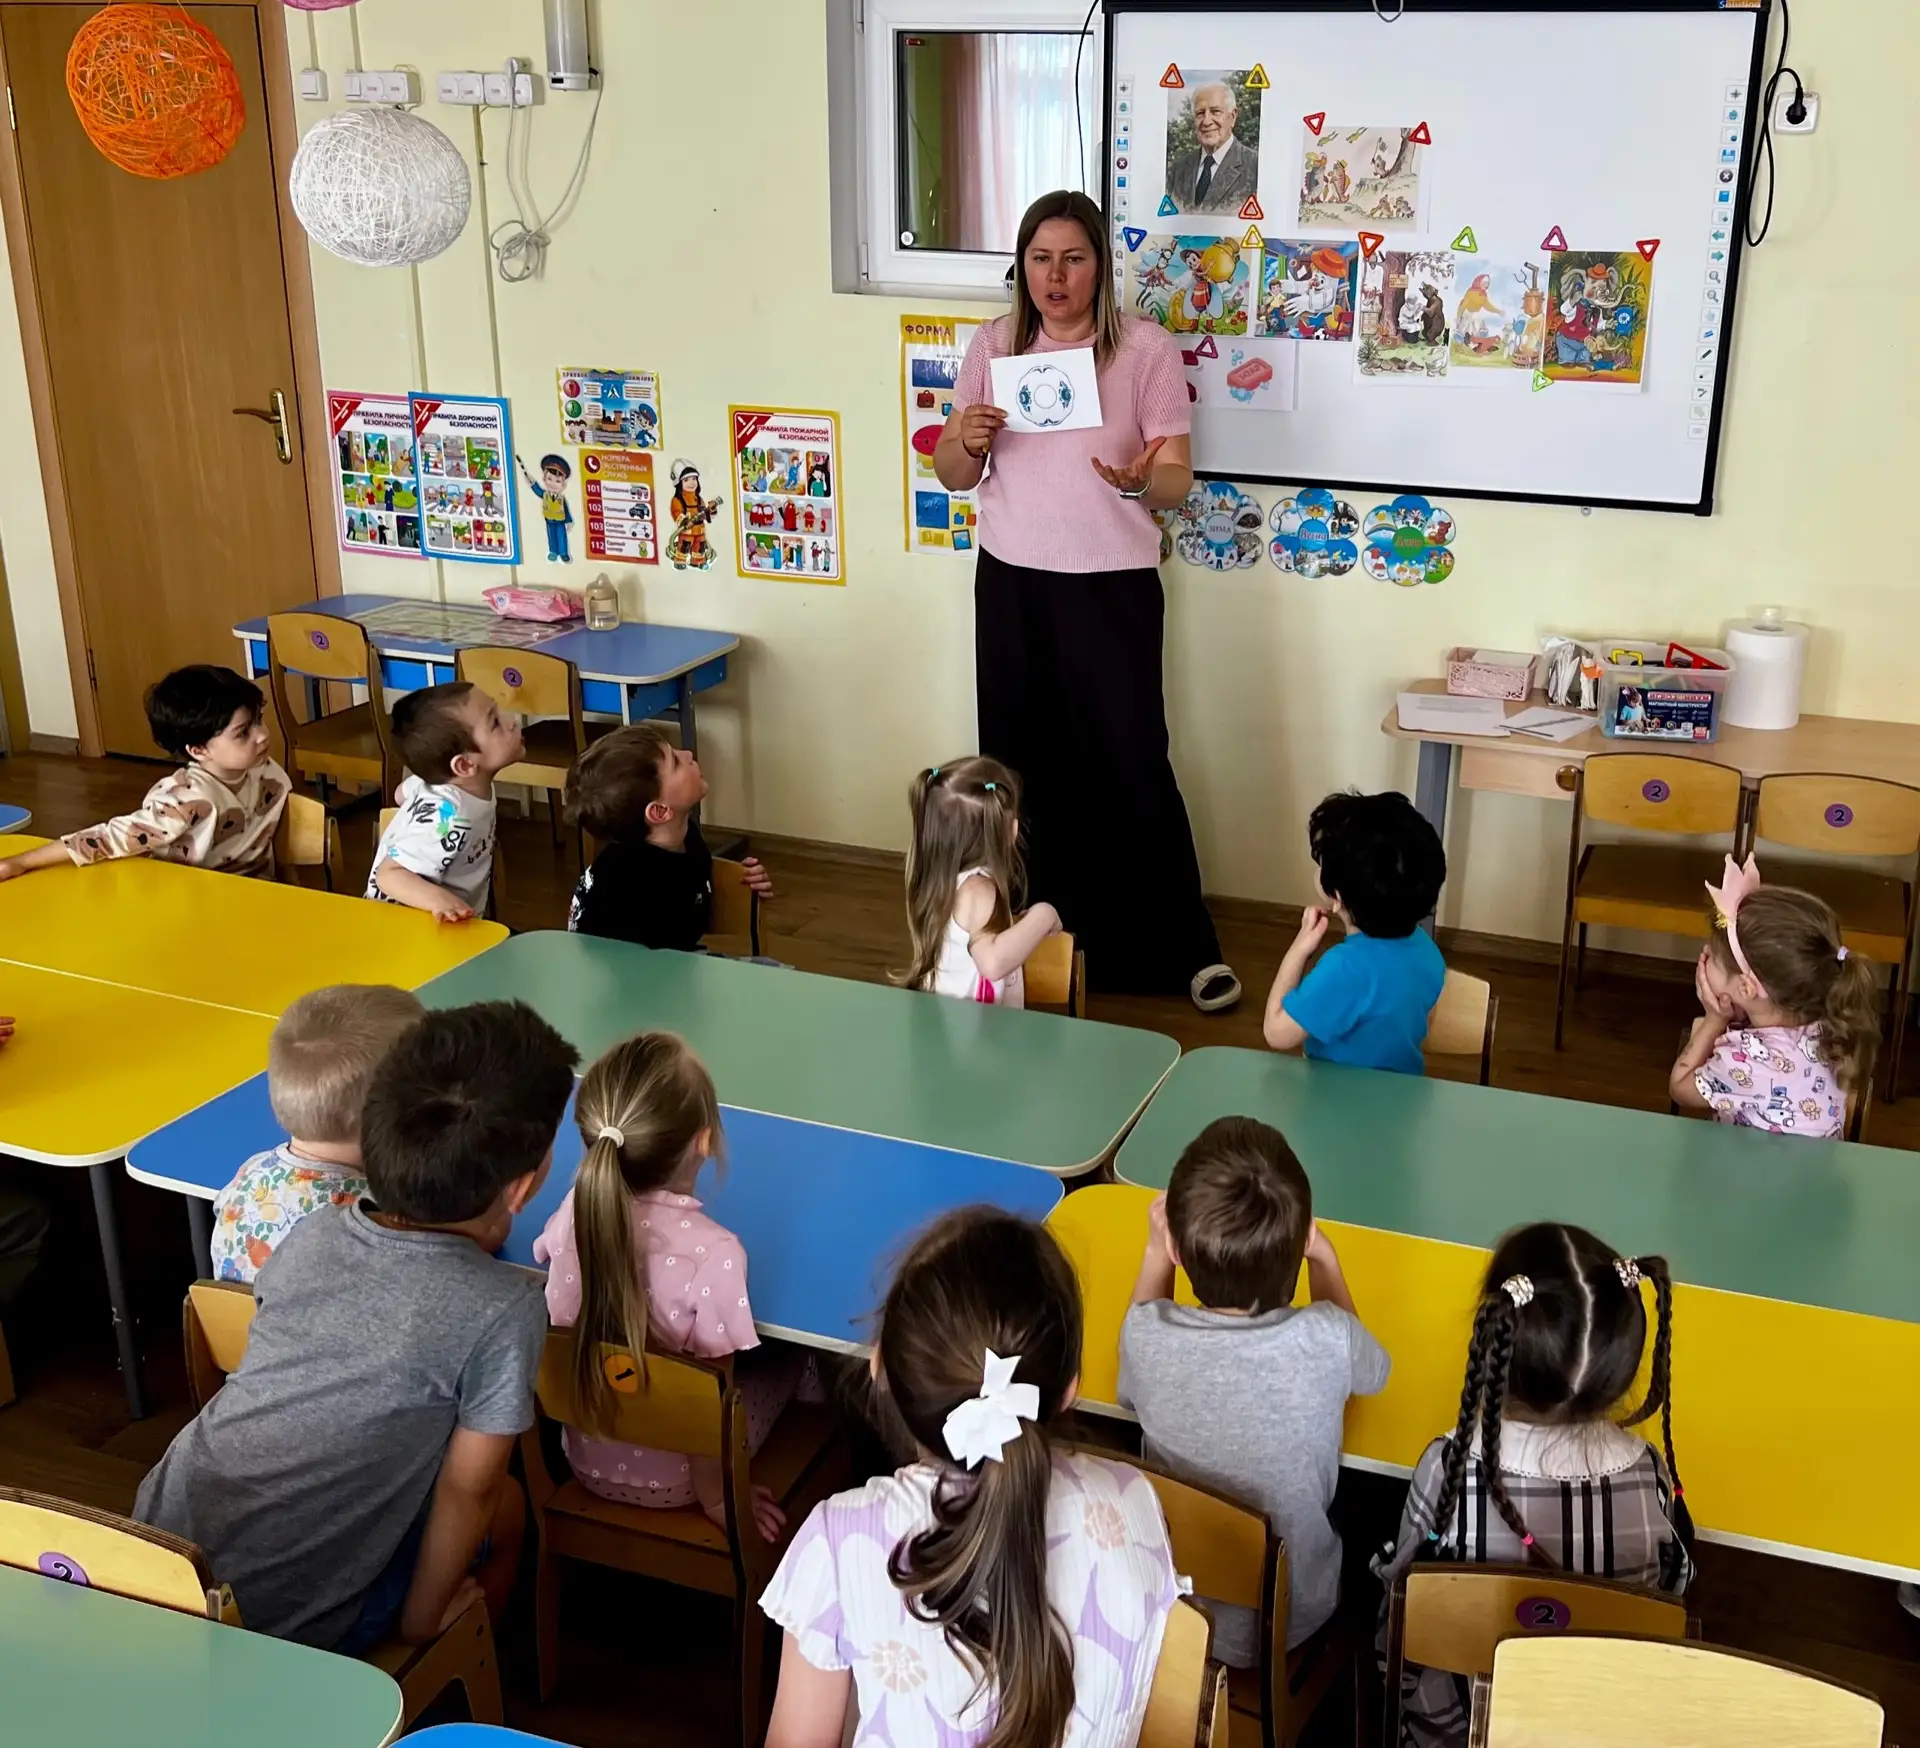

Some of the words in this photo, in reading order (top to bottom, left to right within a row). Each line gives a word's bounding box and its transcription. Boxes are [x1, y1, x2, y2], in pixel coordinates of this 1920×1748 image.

[904, 323, 952, 336] ФОРМА
[353, 410, 383, 419] ПРАВИЛА
[430, 412, 457, 420] ПРАВИЛА
[458, 414, 497, 422] ДОРОЖНОЙ
[449, 421, 498, 430] БЕЗОПАСНОСТИ
[757, 425, 788, 433] ПРАВИЛА
[789, 427, 829, 436] ПОЖАРНОЙ
[778, 433, 829, 443] БЕЗОПАСНОСТИ
[587, 484, 600, 493] 101
[588, 503, 602, 512] 102
[590, 522, 604, 531] 103
[1208, 525, 1232, 533] ЗИМА
[1300, 528, 1327, 541] Весна
[591, 541, 605, 550] 112
[316, 634, 325, 645] 2
[508, 672, 517, 683] 2
[1651, 784, 1662, 797] 2
[1834, 809, 1845, 822] 2
[1533, 1603, 1557, 1625] 2
